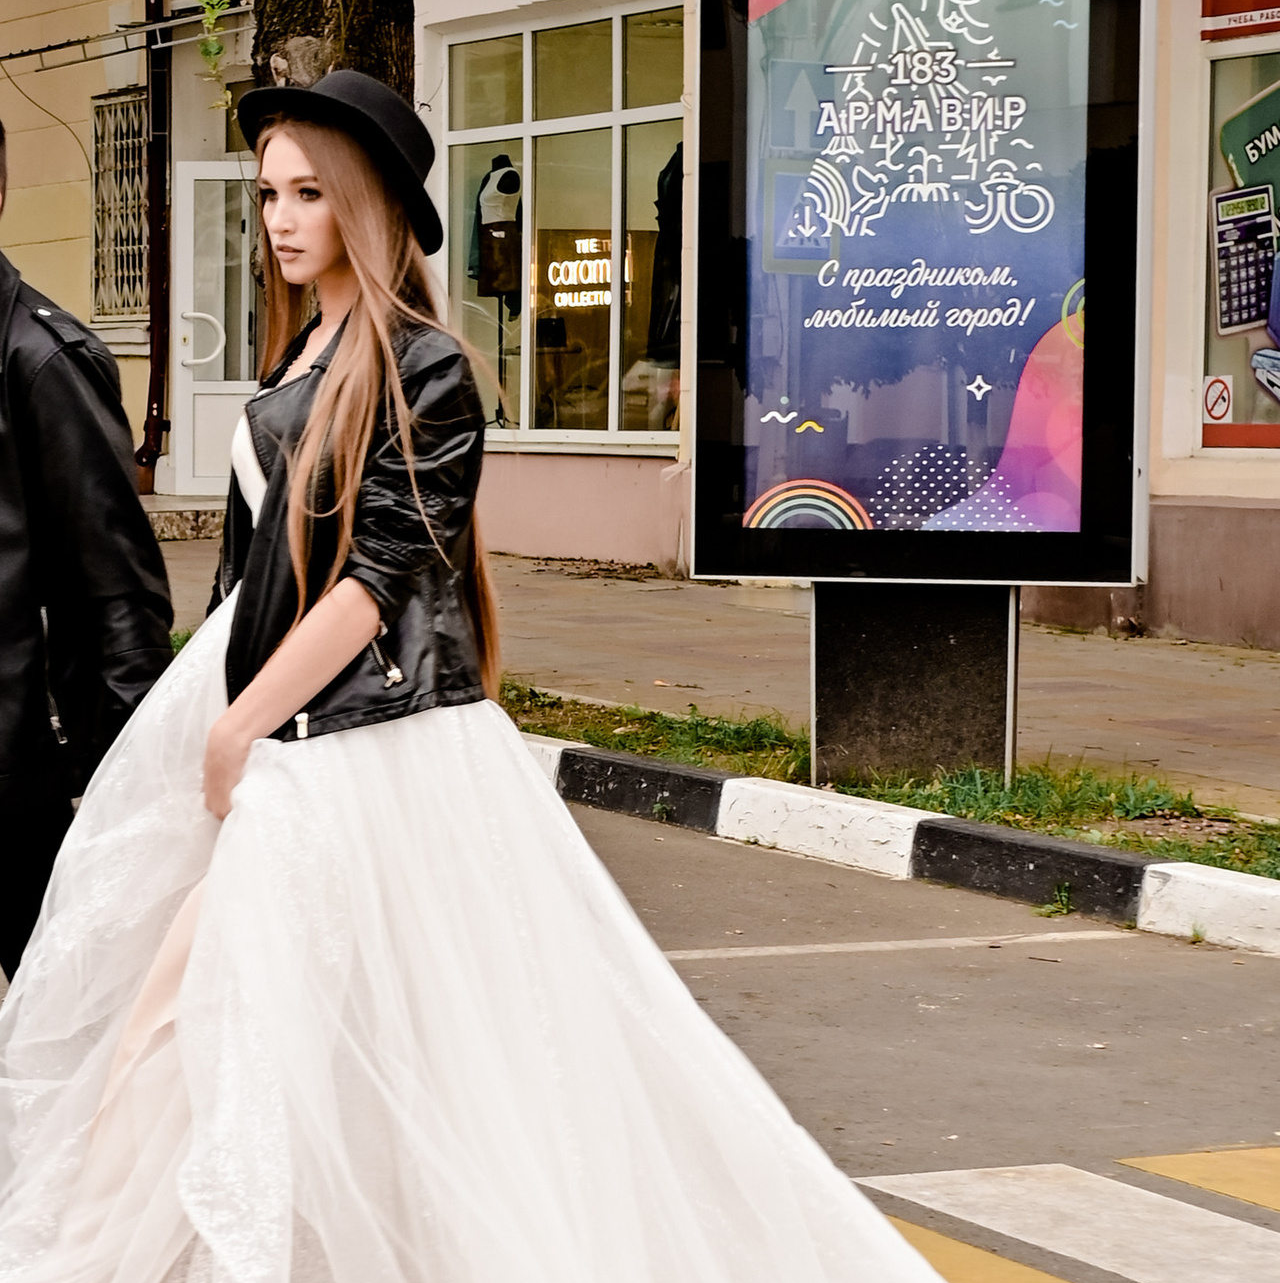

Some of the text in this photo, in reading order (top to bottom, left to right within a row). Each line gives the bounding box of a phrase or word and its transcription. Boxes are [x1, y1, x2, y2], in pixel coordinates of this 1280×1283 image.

[889, 50, 958, 86] 183
[816, 95, 1028, 136] АРМАВИР
[548, 259, 630, 286] caraml
[817, 258, 1019, 299] С праздником,
[554, 290, 612, 308] COLLECTIO
[803, 296, 1036, 336] любимый город!
